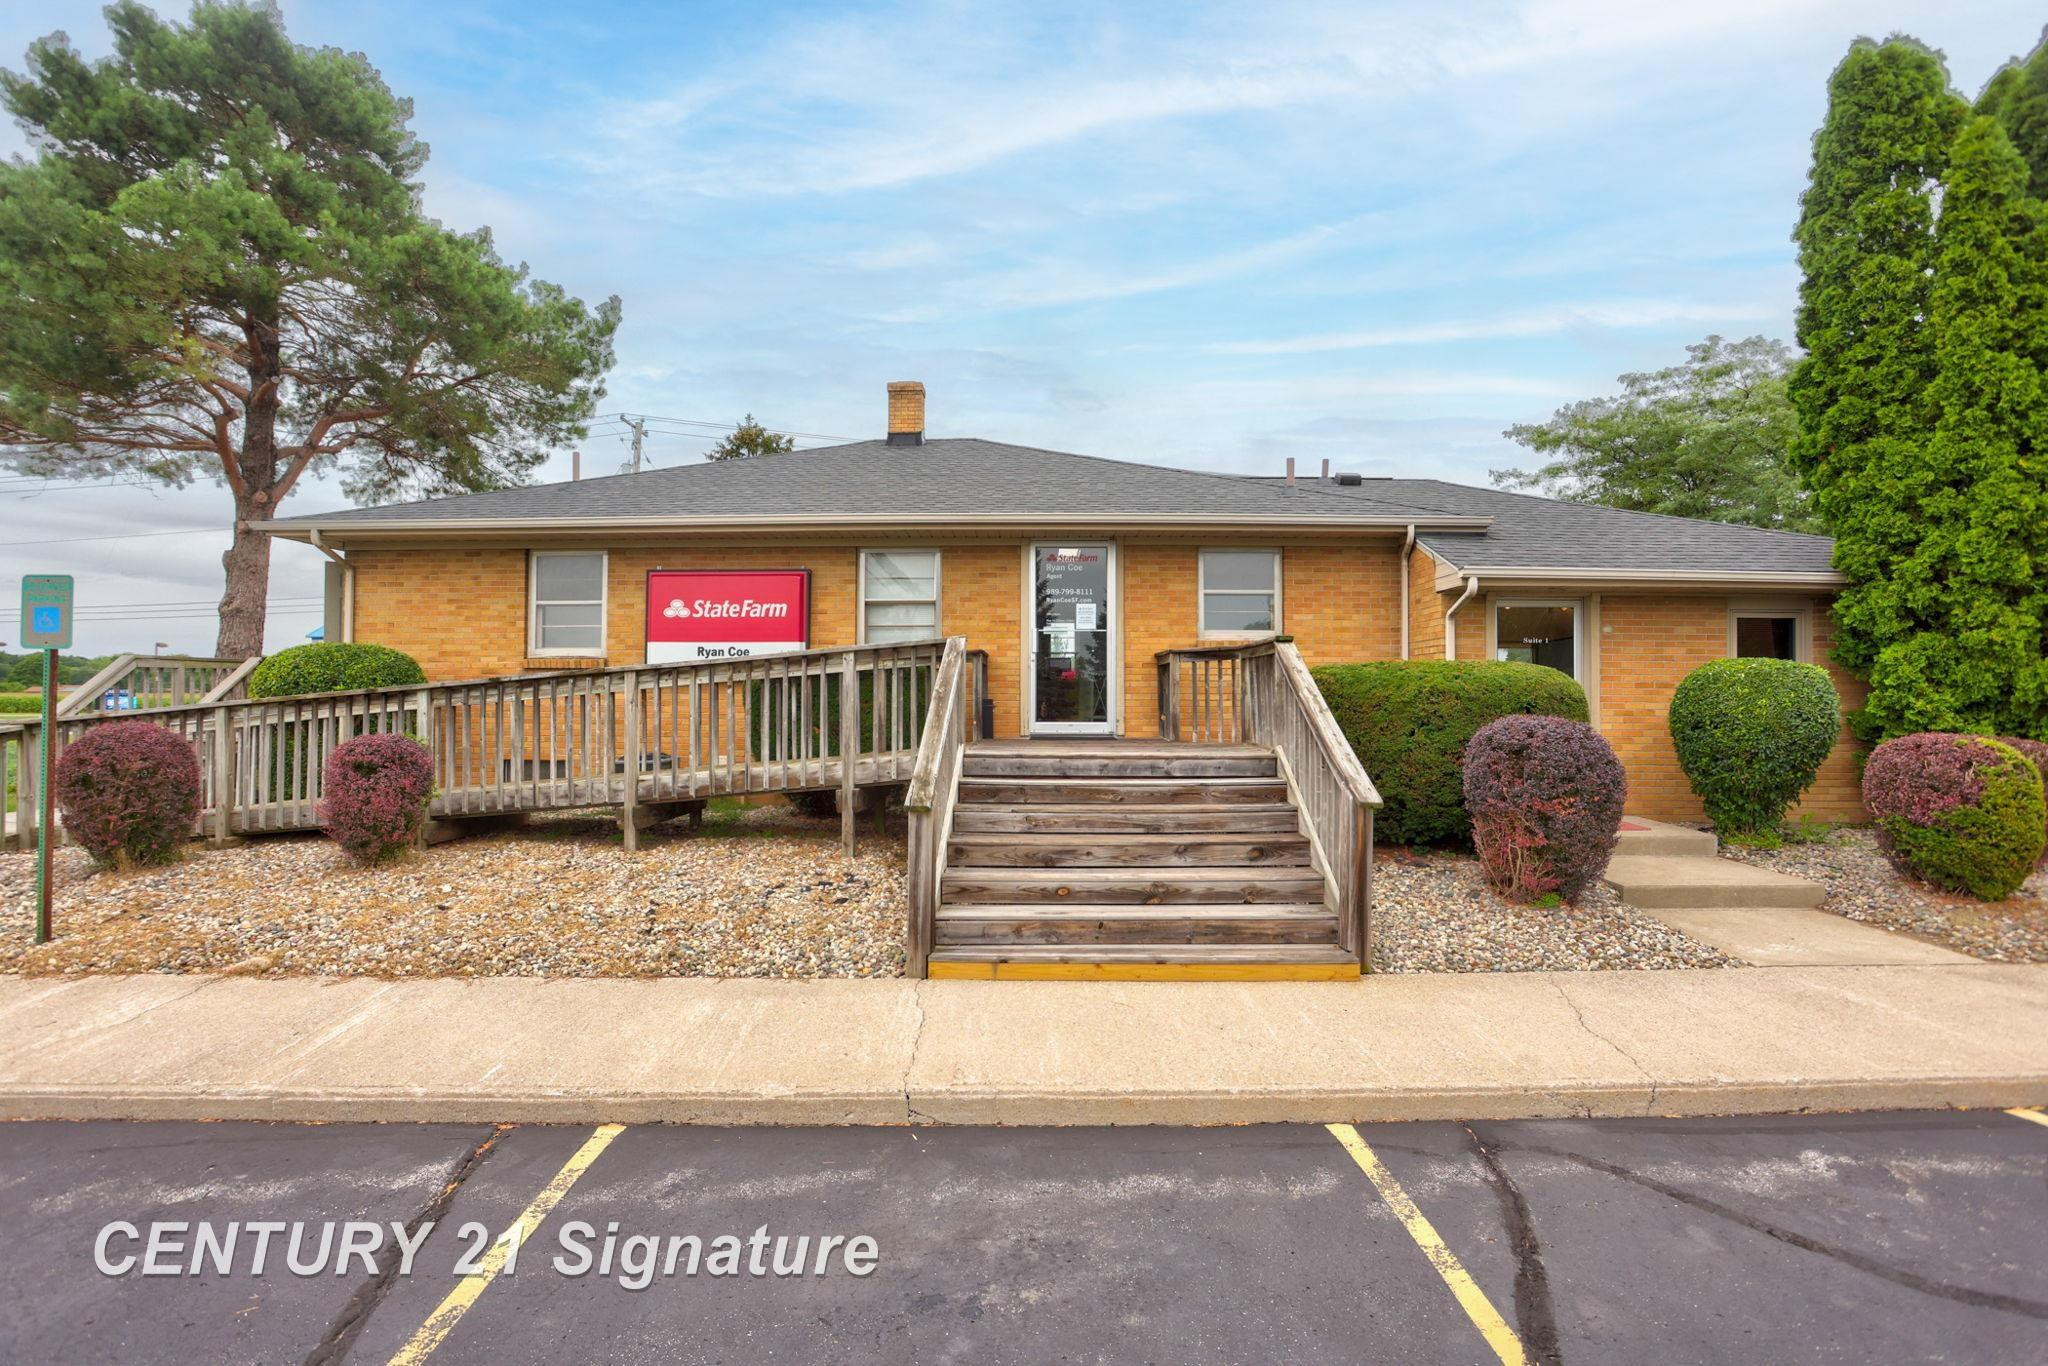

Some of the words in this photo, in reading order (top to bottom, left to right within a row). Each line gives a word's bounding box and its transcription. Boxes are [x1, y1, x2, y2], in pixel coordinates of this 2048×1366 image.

[1046, 564, 1066, 572] Ryan
[697, 646, 725, 659] Ryan
[728, 646, 750, 657] Coe
